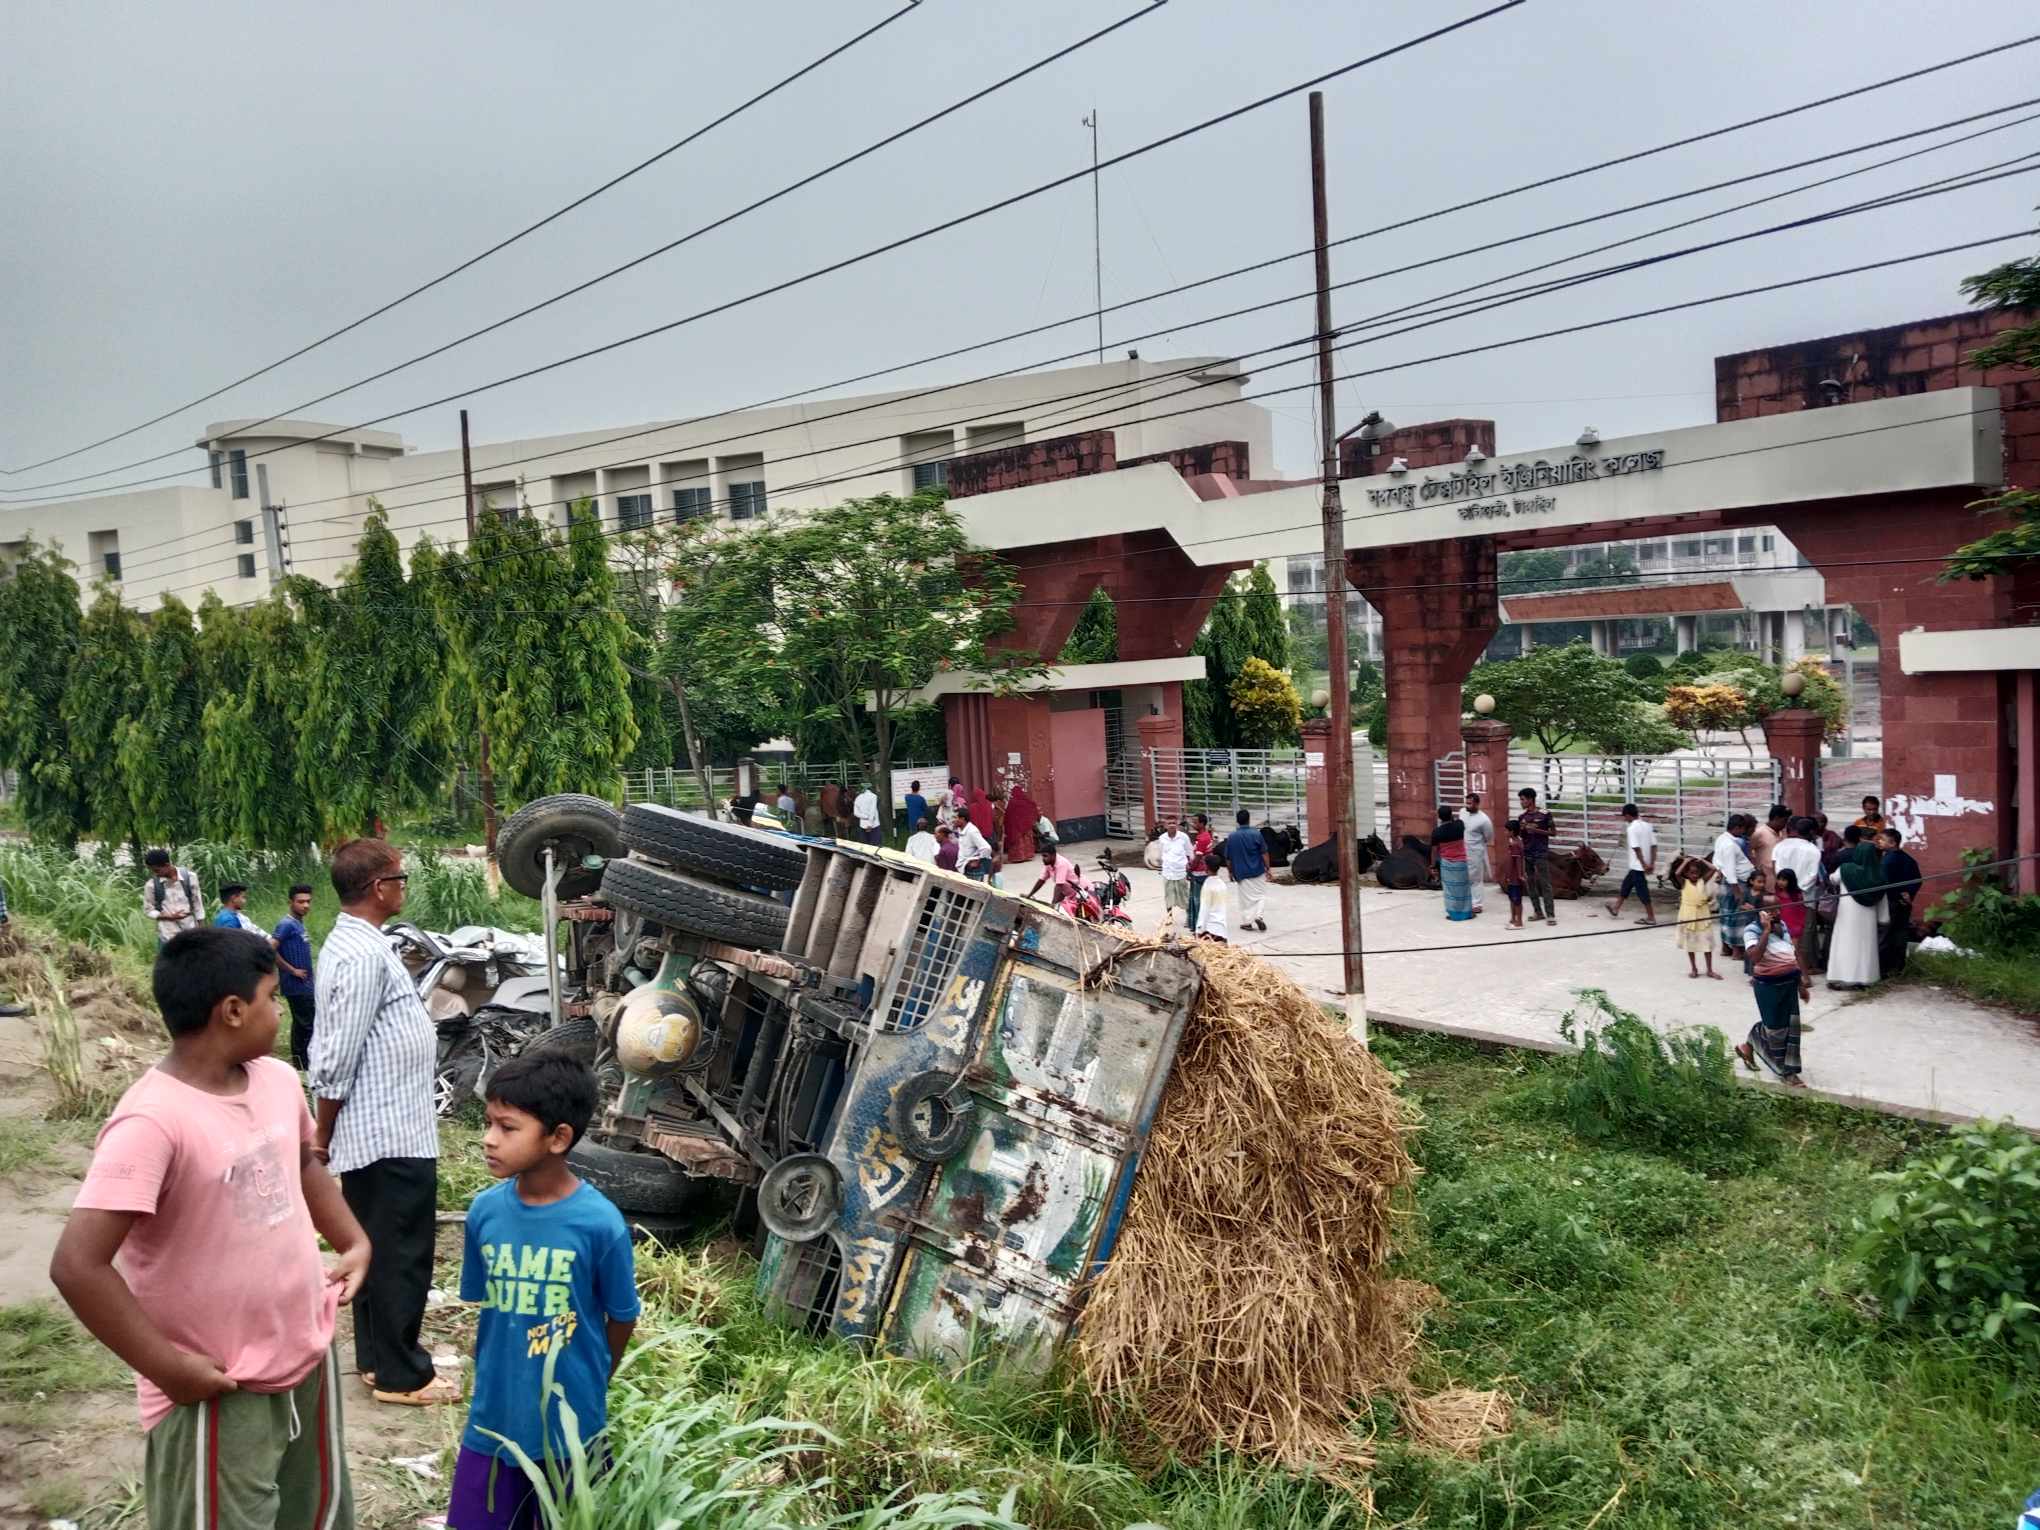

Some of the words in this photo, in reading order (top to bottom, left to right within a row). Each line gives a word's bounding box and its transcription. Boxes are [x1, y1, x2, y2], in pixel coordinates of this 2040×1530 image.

[1601, 449, 1665, 477] কলেজ
[527, 1323, 550, 1340] NOT
[551, 1311, 577, 1331] FOR
